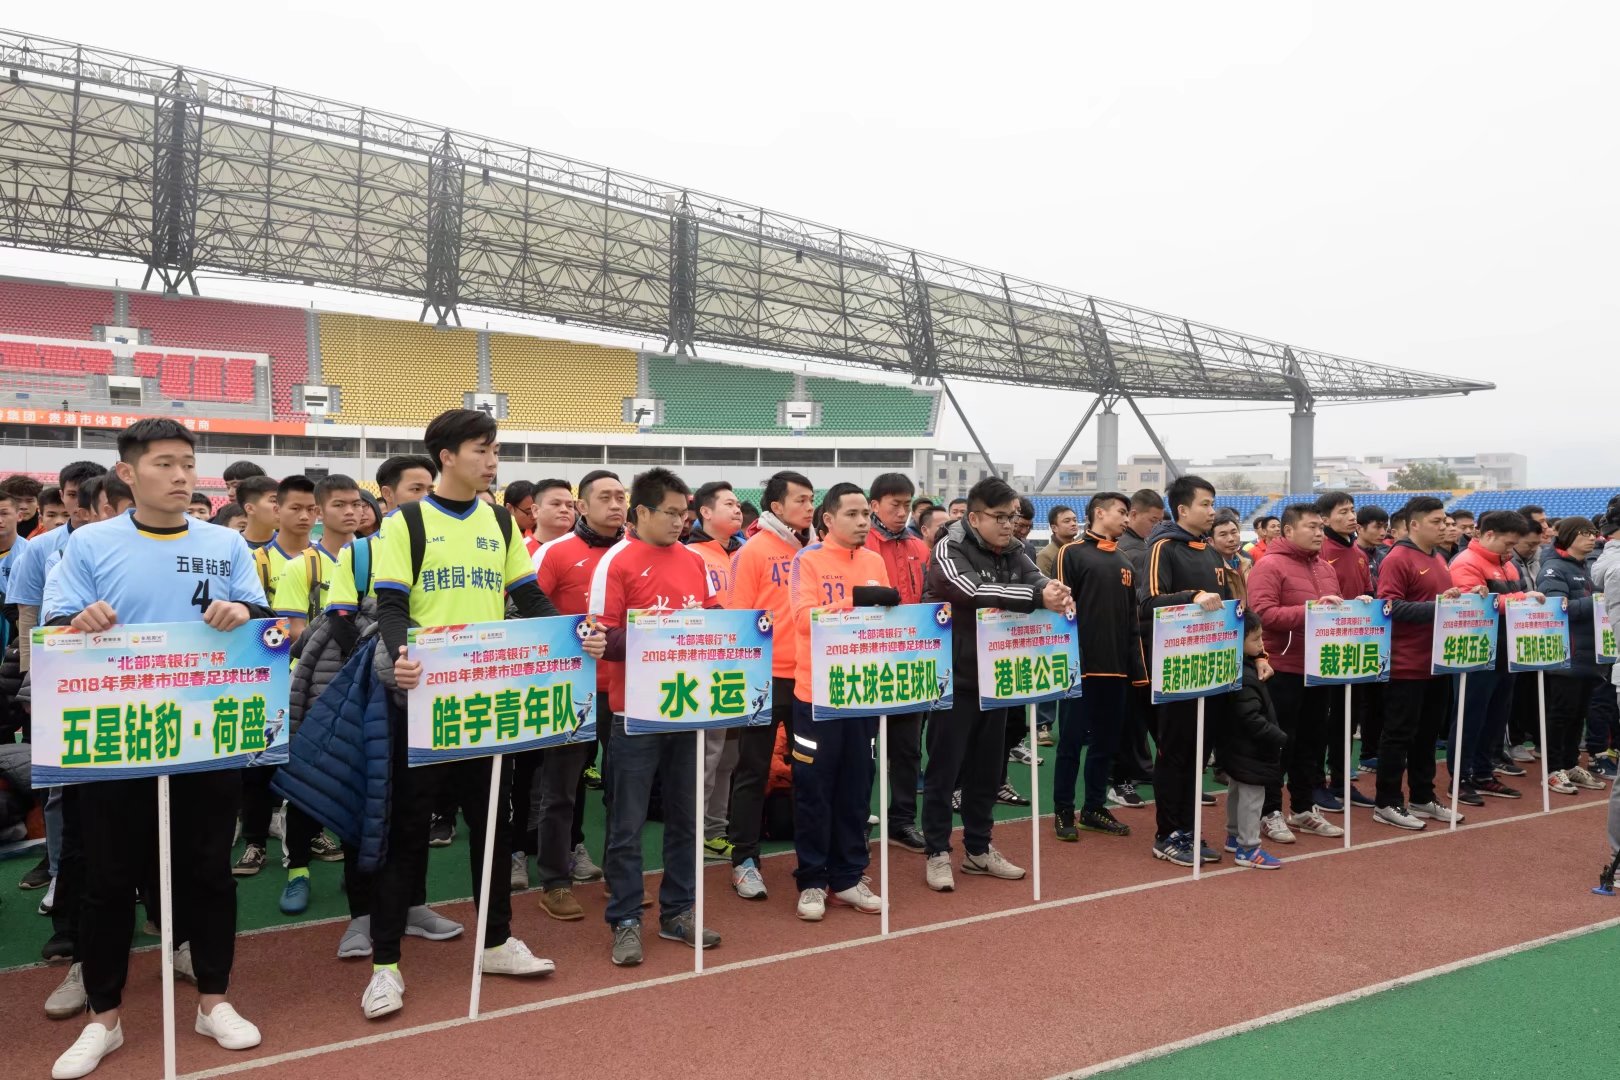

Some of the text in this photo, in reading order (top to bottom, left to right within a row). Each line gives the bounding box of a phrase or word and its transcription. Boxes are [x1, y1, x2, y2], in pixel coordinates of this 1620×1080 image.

[426, 536, 445, 544] LME
[476, 536, 500, 552] 皓宇
[176, 556, 231, 577] 五星钻豹
[1121, 568, 1132, 587] 30
[422, 566, 503, 593] 碧桂园·城央府
[191, 578, 213, 613] 4
[822, 582, 846, 606] 33
[671, 634, 737, 646] “北部湾银行”杯
[853, 627, 917, 640] “北部湾银行”杯
[988, 633, 1071, 651] 2018年贵港市迎春足球比赛
[462, 644, 549, 664] “北部湾银行”杯
[642, 647, 762, 662] 2018年贵港市迎春足球比赛
[826, 638, 941, 655] 2018年贵港市迎春足球比赛
[1443, 633, 1490, 666] 华邦五金
[107, 651, 227, 671] “北部湾银行”杯
[426, 657, 583, 686] 2018年贵港市迎春足球比赛
[1162, 647, 1238, 694] 贵港市阿波罗足球队
[1320, 643, 1379, 677] 裁判员
[56, 667, 272, 693] 2018年贵港市迎春足球比赛
[829, 659, 940, 707] 雄大球会足球队
[994, 653, 1070, 698] 港峰公司
[660, 671, 746, 719] 水运
[431, 681, 578, 749] 皓宇青年队
[60, 694, 267, 767] 五星钻豹·荷盛
